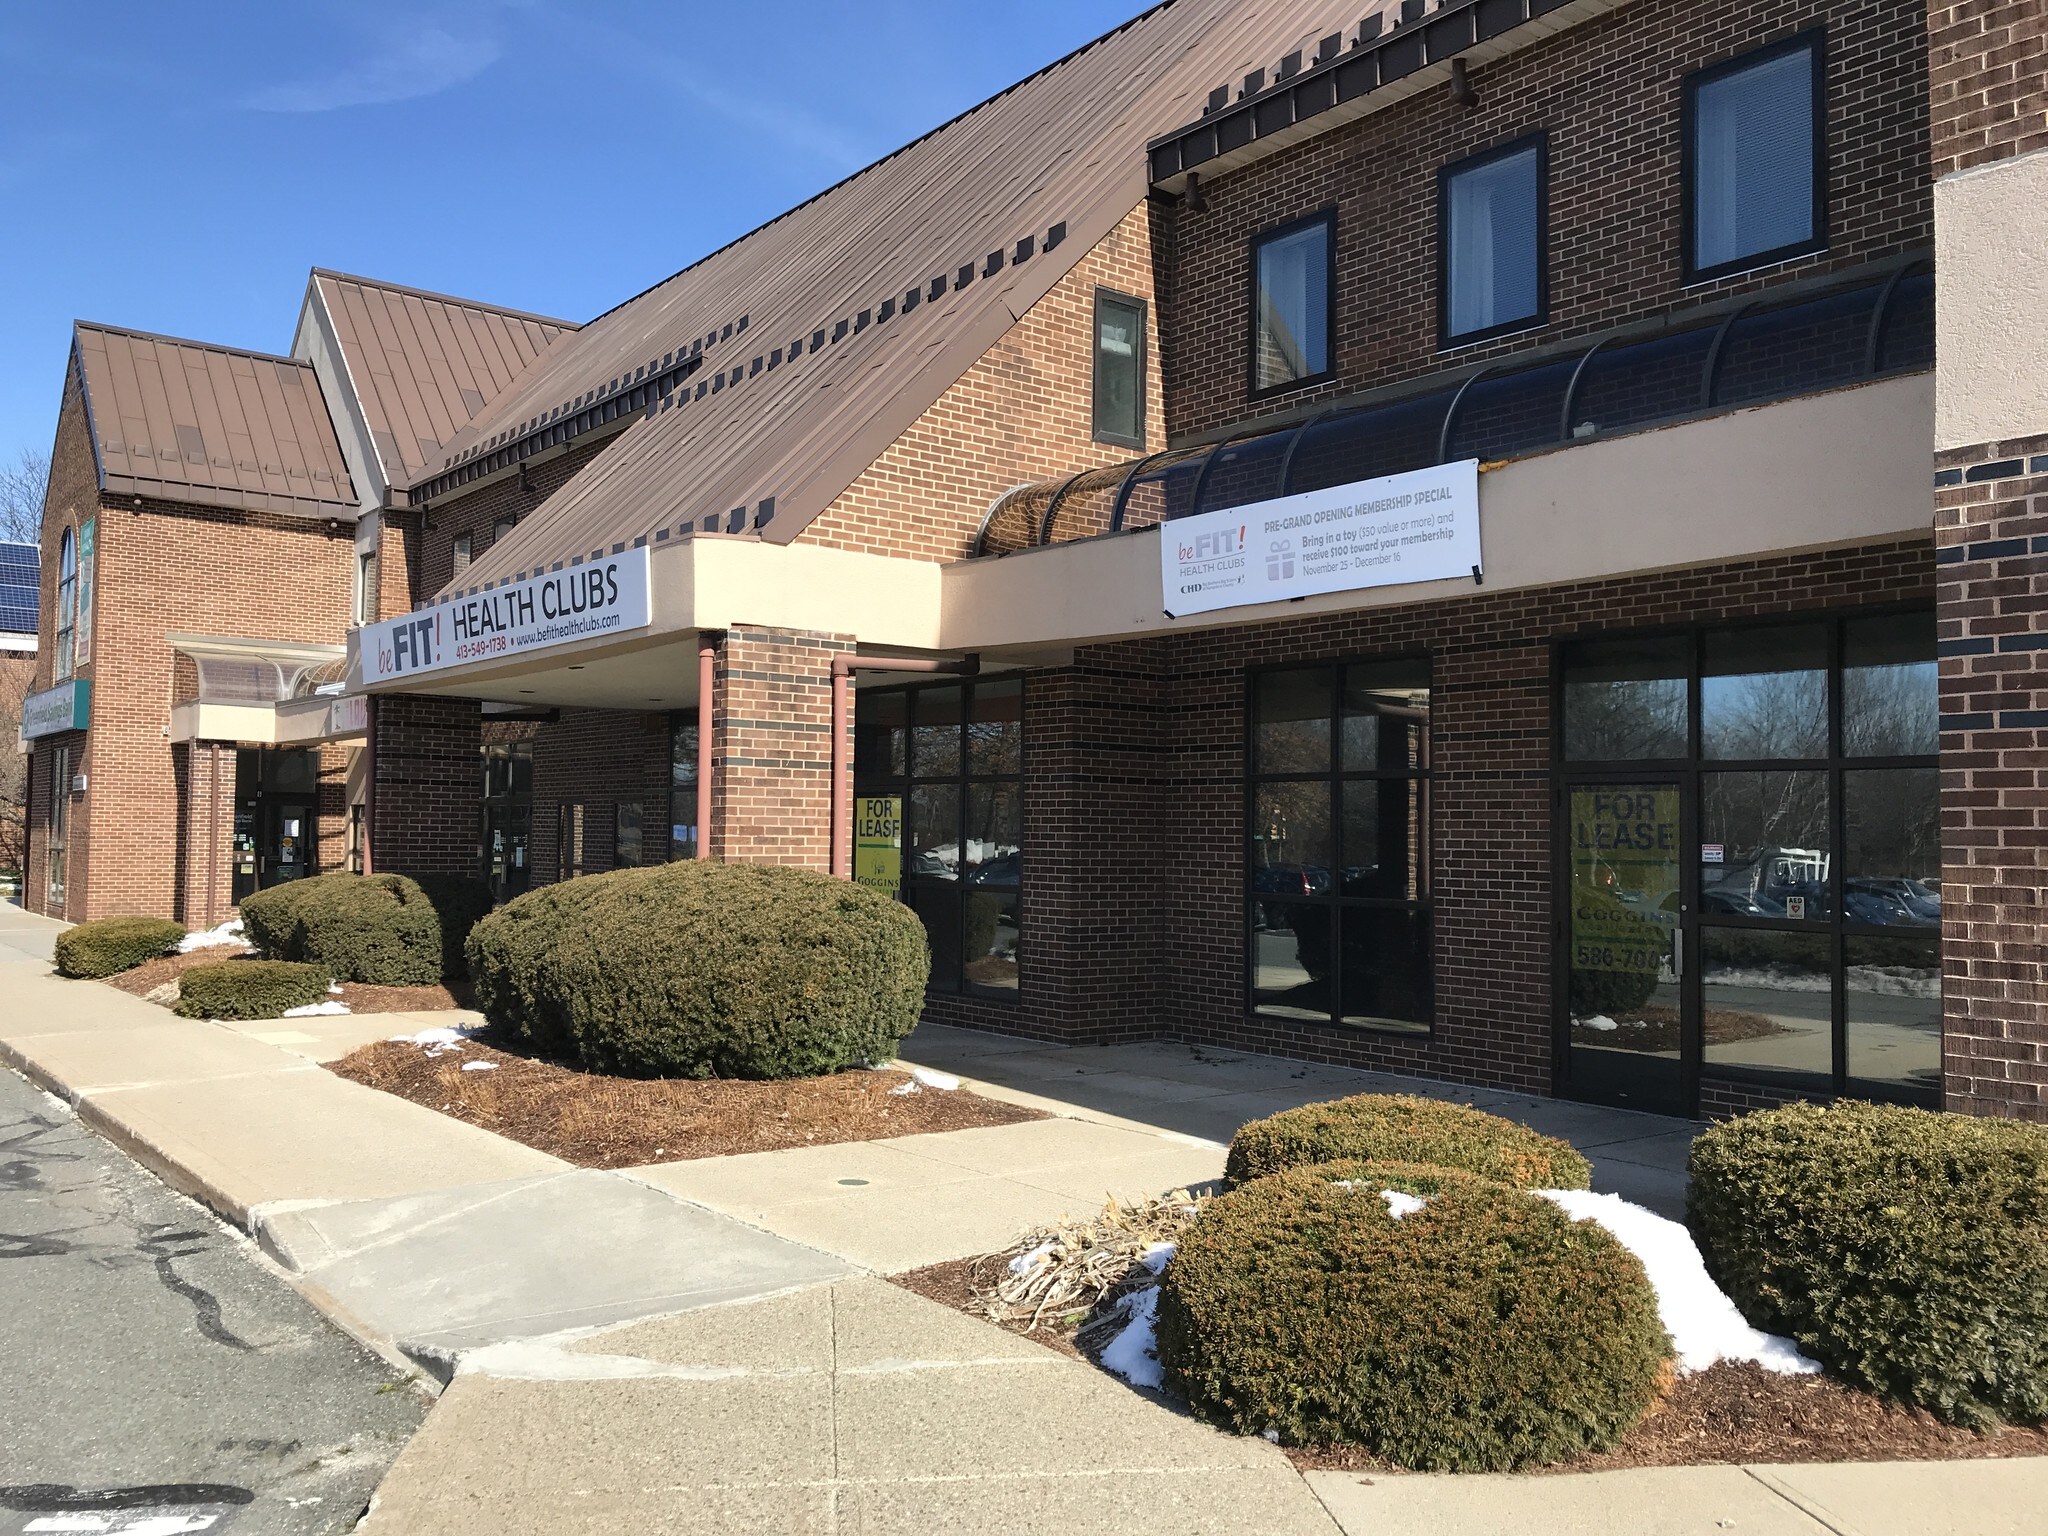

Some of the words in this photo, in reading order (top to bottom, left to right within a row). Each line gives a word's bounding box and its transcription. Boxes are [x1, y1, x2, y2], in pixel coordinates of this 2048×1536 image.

[1264, 514, 1312, 533] PRE-GRAND
[1314, 506, 1353, 524] OPENING
[1355, 494, 1412, 516] MEMBERSHIP
[1414, 487, 1452, 505] SPECIAL
[1302, 535, 1324, 548] Bring
[1325, 532, 1334, 544] in
[1335, 533, 1341, 542] a
[1343, 530, 1357, 543] toy
[1359, 526, 1376, 539] ($50
[1377, 521, 1399, 534] value
[1400, 521, 1409, 531] or
[1411, 513, 1435, 529] more)
[1437, 510, 1454, 524] and
[1302, 548, 1329, 562] receive
[1330, 545, 1349, 557] $100
[1350, 538, 1379, 554] toward
[1380, 538, 1399, 551] your
[1401, 527, 1454, 546] membership
[1180, 563, 1215, 577] HEALTH
[1217, 557, 1245, 570] CLUBS
[1303, 561, 1338, 576] November
[1340, 561, 1348, 570] 25
[1355, 553, 1392, 568] December
[1393, 551, 1401, 562] 16
[1180, 583, 1202, 594] CHD
[452, 586, 535, 641] HEALTH
[542, 564, 618, 620] CLUBS
[456, 636, 507, 660] 413-549-1738
[516, 611, 620, 647] www.befithealthclubs.com
[866, 799, 893, 818] FOR
[1594, 793, 1656, 820] FOR
[858, 819, 900, 838] LEASE
[1577, 823, 1674, 850] LEASE
[857, 875, 899, 888] GOGGINS
